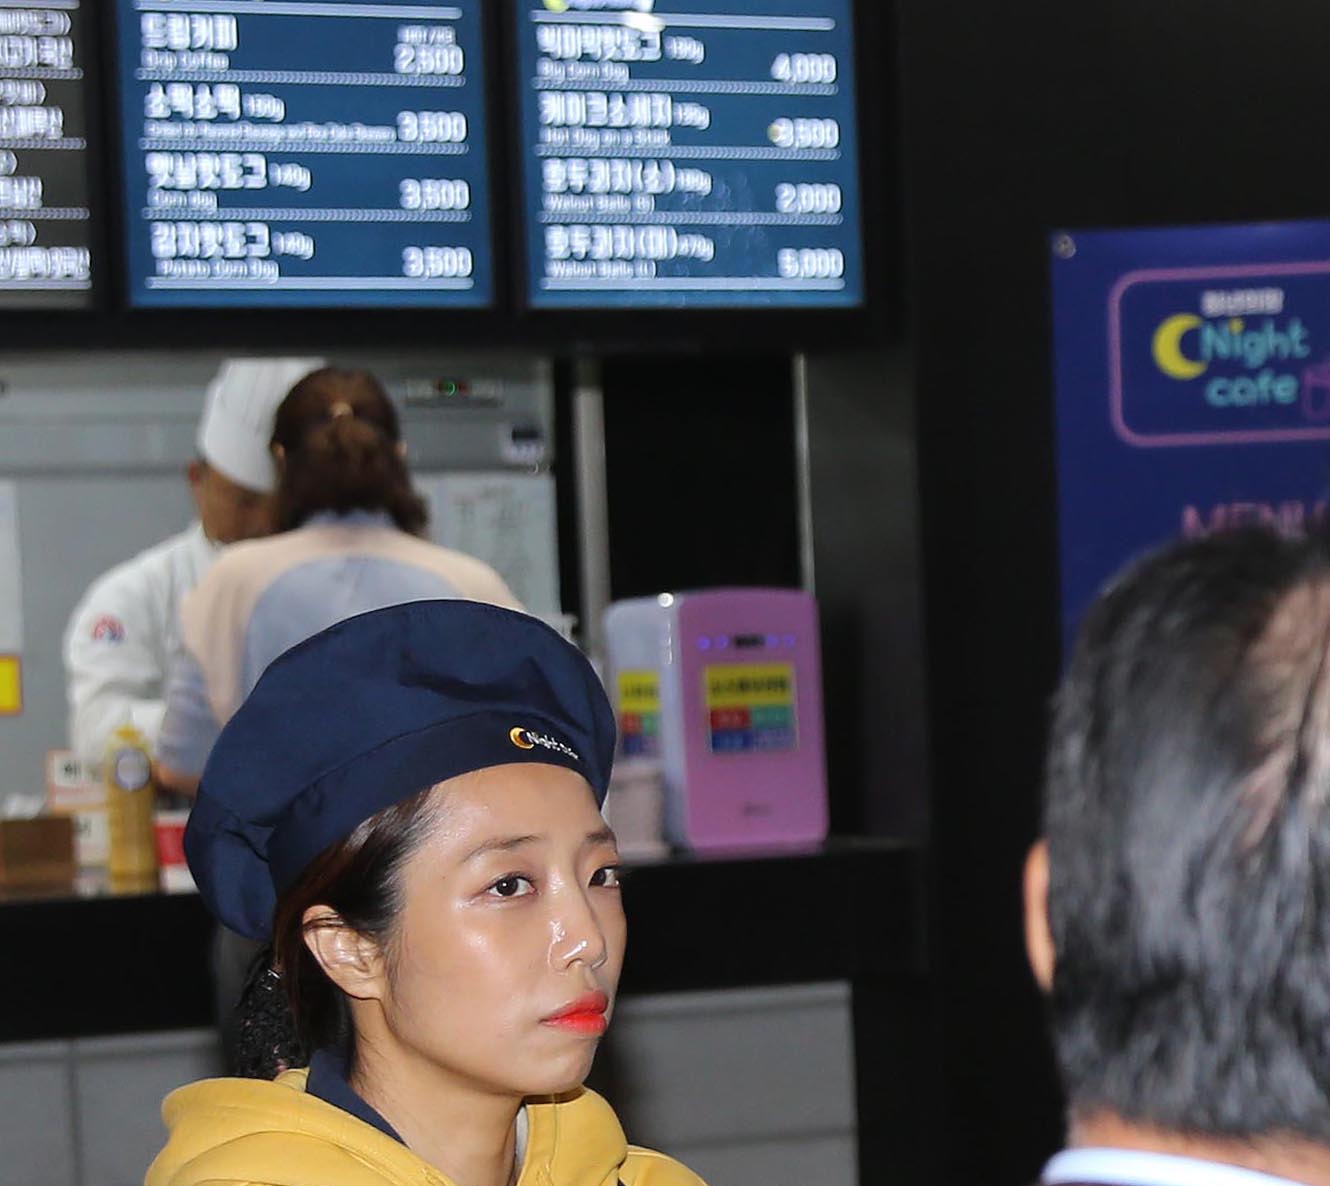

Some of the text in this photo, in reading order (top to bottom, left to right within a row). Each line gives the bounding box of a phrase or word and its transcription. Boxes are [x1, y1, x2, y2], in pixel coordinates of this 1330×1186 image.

[393, 43, 464, 76] 2,500
[770, 52, 837, 85] 4,000
[396, 111, 468, 143] 3,500
[399, 178, 470, 212] 3,500
[774, 182, 842, 215] 2,000
[402, 246, 473, 280] 3,500
[1201, 318, 1310, 367] Night
[1206, 369, 1299, 408] cafe
